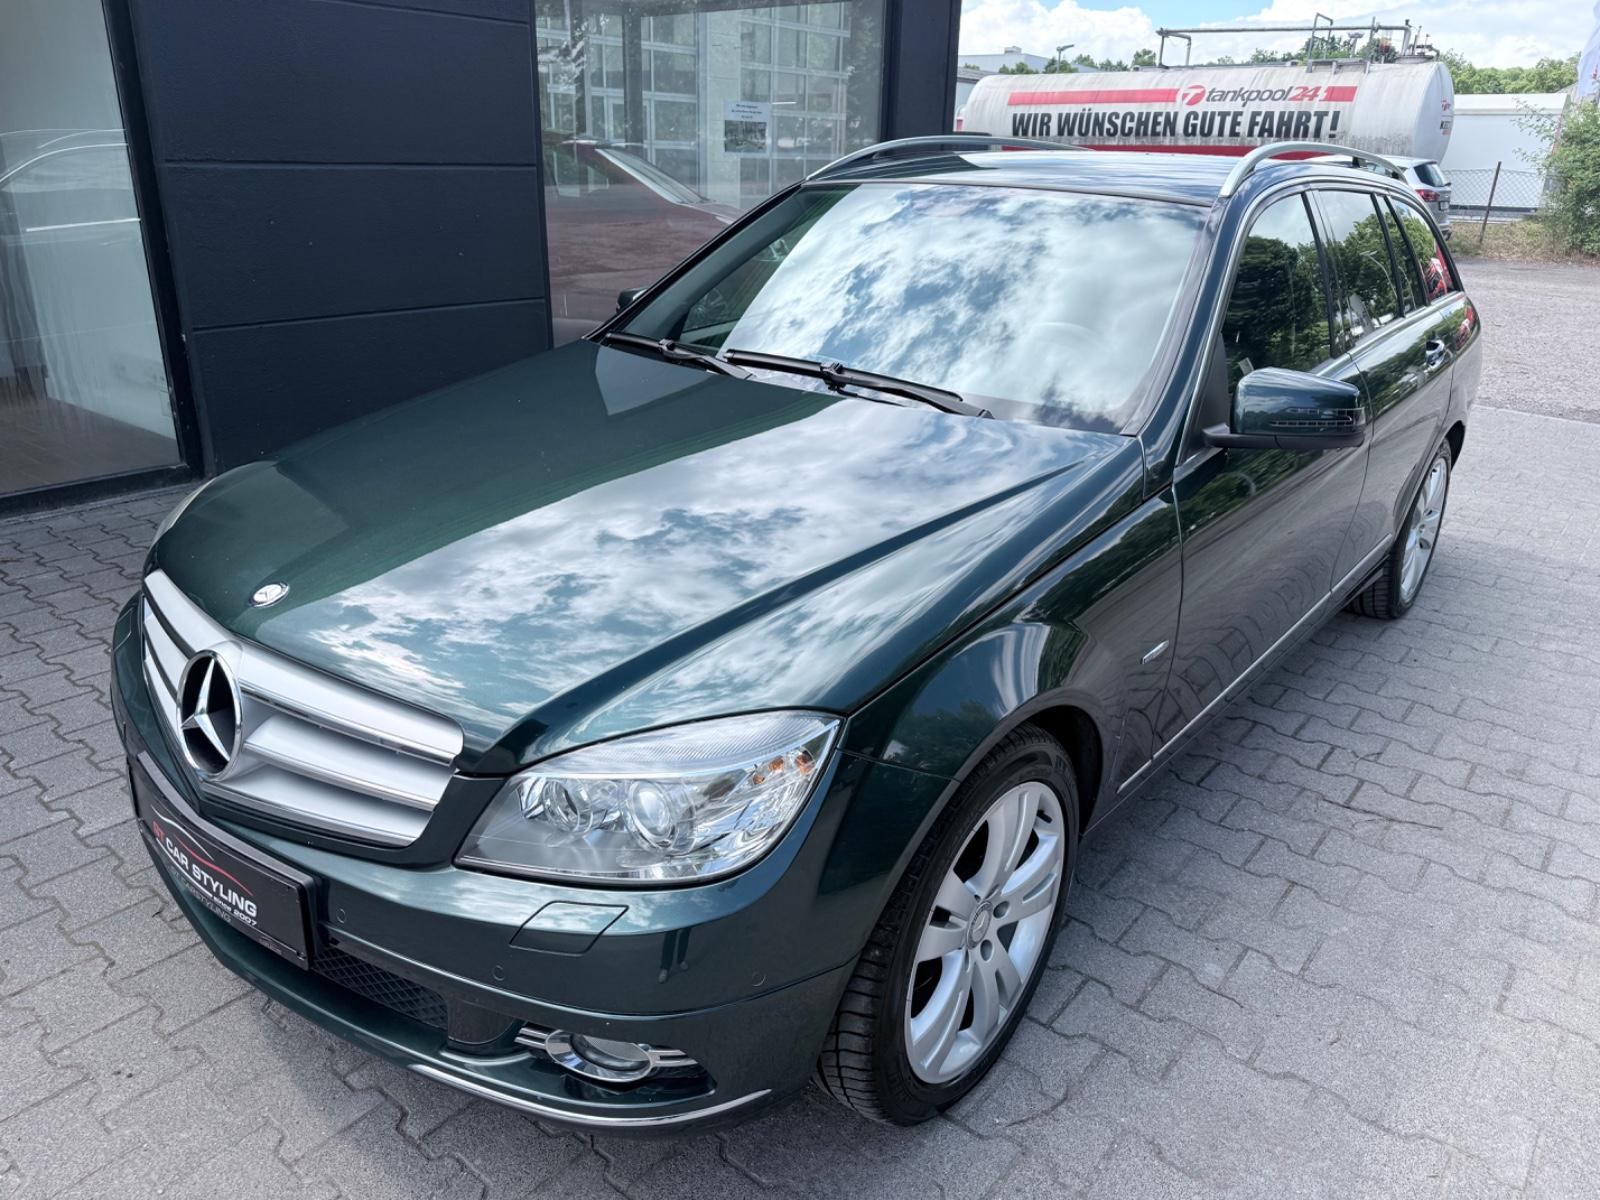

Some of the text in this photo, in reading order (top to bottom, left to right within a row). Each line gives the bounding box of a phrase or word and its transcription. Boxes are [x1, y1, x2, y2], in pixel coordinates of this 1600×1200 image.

[1206, 85, 1323, 108] tankpool24
[1012, 107, 1341, 139] WIR WÜNSCHEN GUTE FAHRT!
[165, 836, 189, 870] CAR
[192, 863, 258, 918] STYLING
[233, 908, 257, 926] 2007
